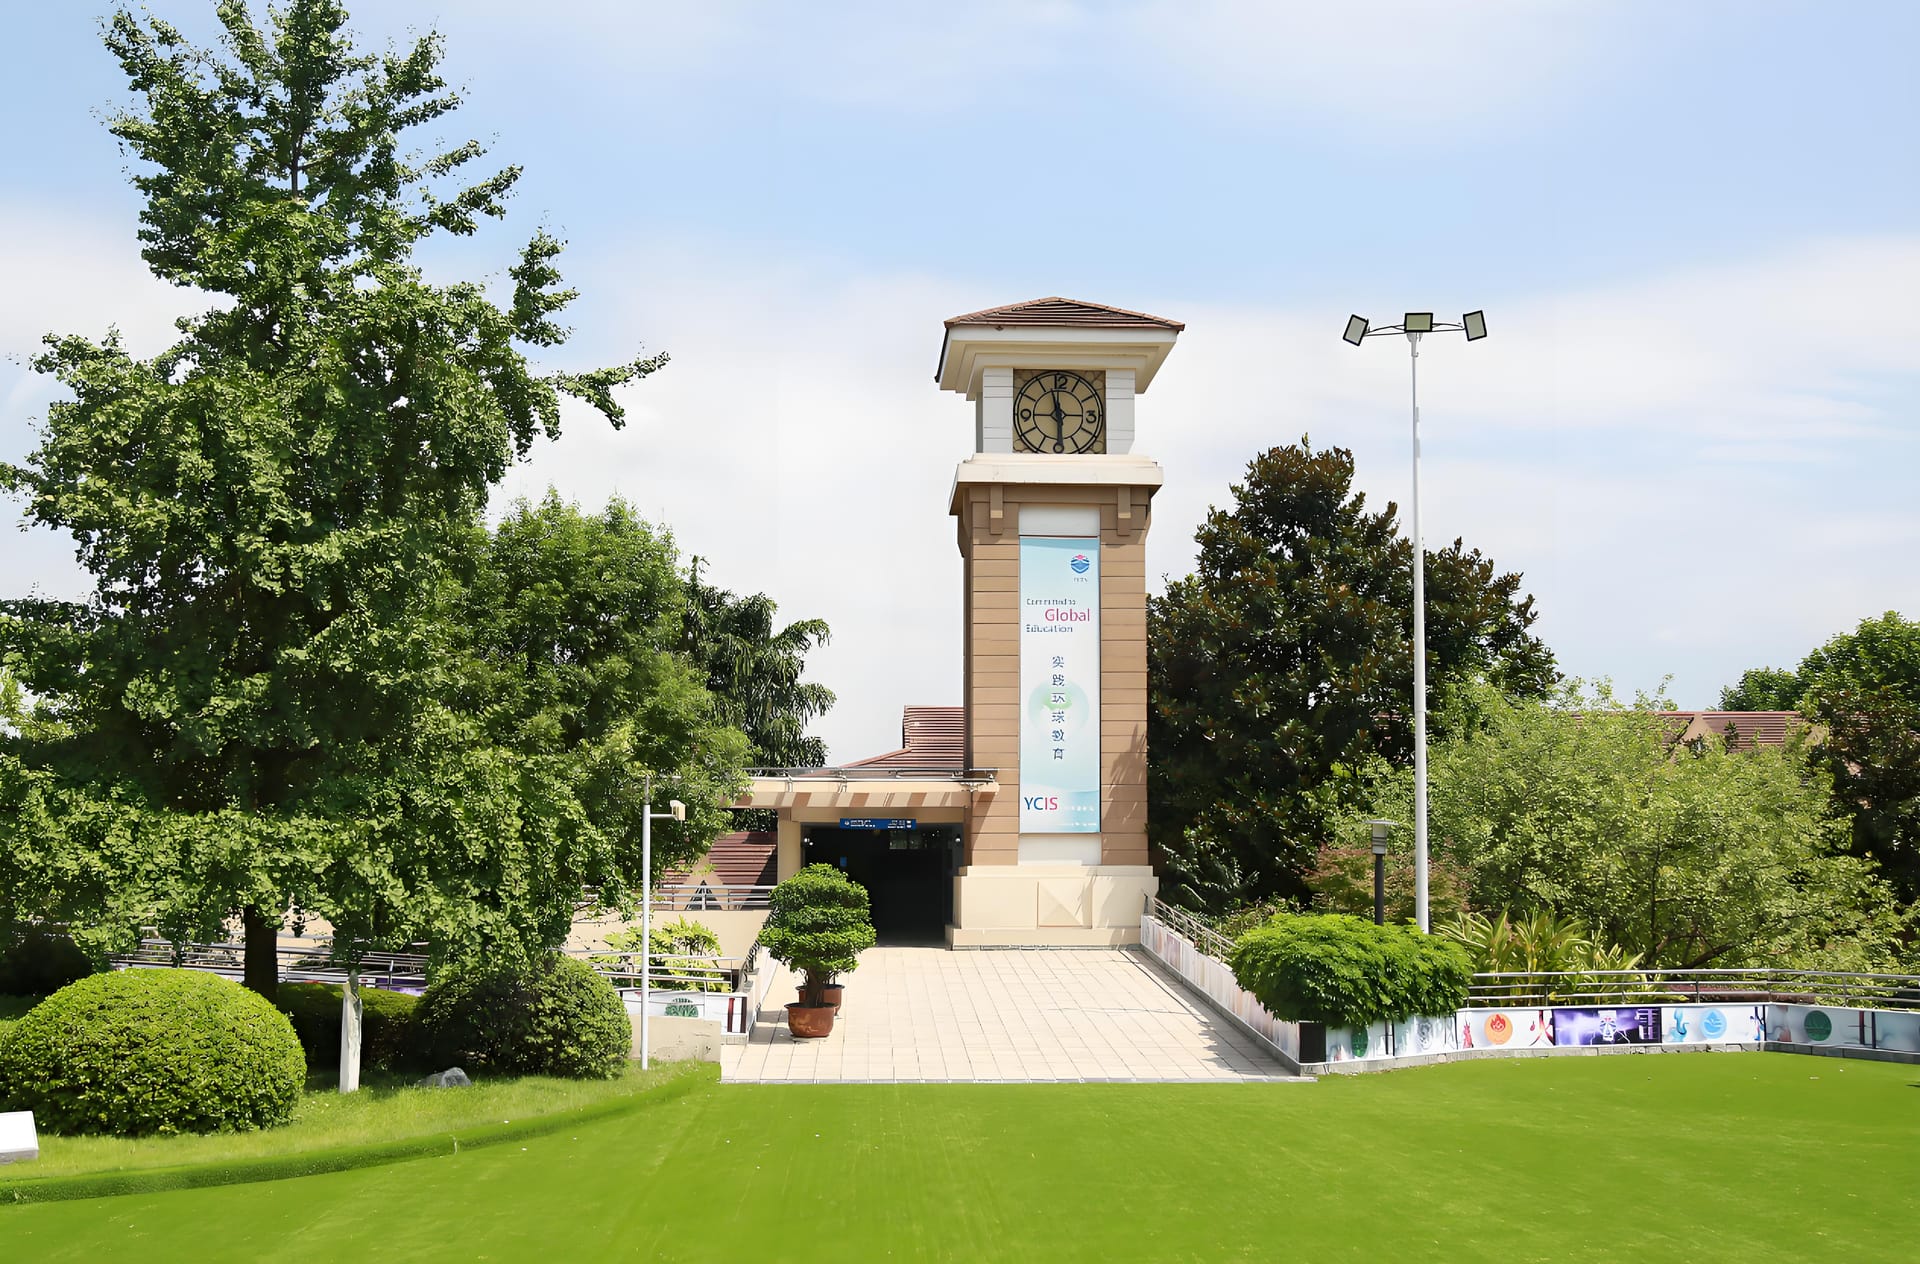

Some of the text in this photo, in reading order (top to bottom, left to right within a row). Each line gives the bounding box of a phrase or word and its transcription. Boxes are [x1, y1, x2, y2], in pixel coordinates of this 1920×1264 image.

[1054, 374, 1068, 390] 12
[1020, 408, 1032, 423] 9
[1085, 409, 1097, 424] 3
[1044, 607, 1091, 622] Global
[1025, 623, 1073, 633] Education
[1023, 796, 1059, 811] YCIS
